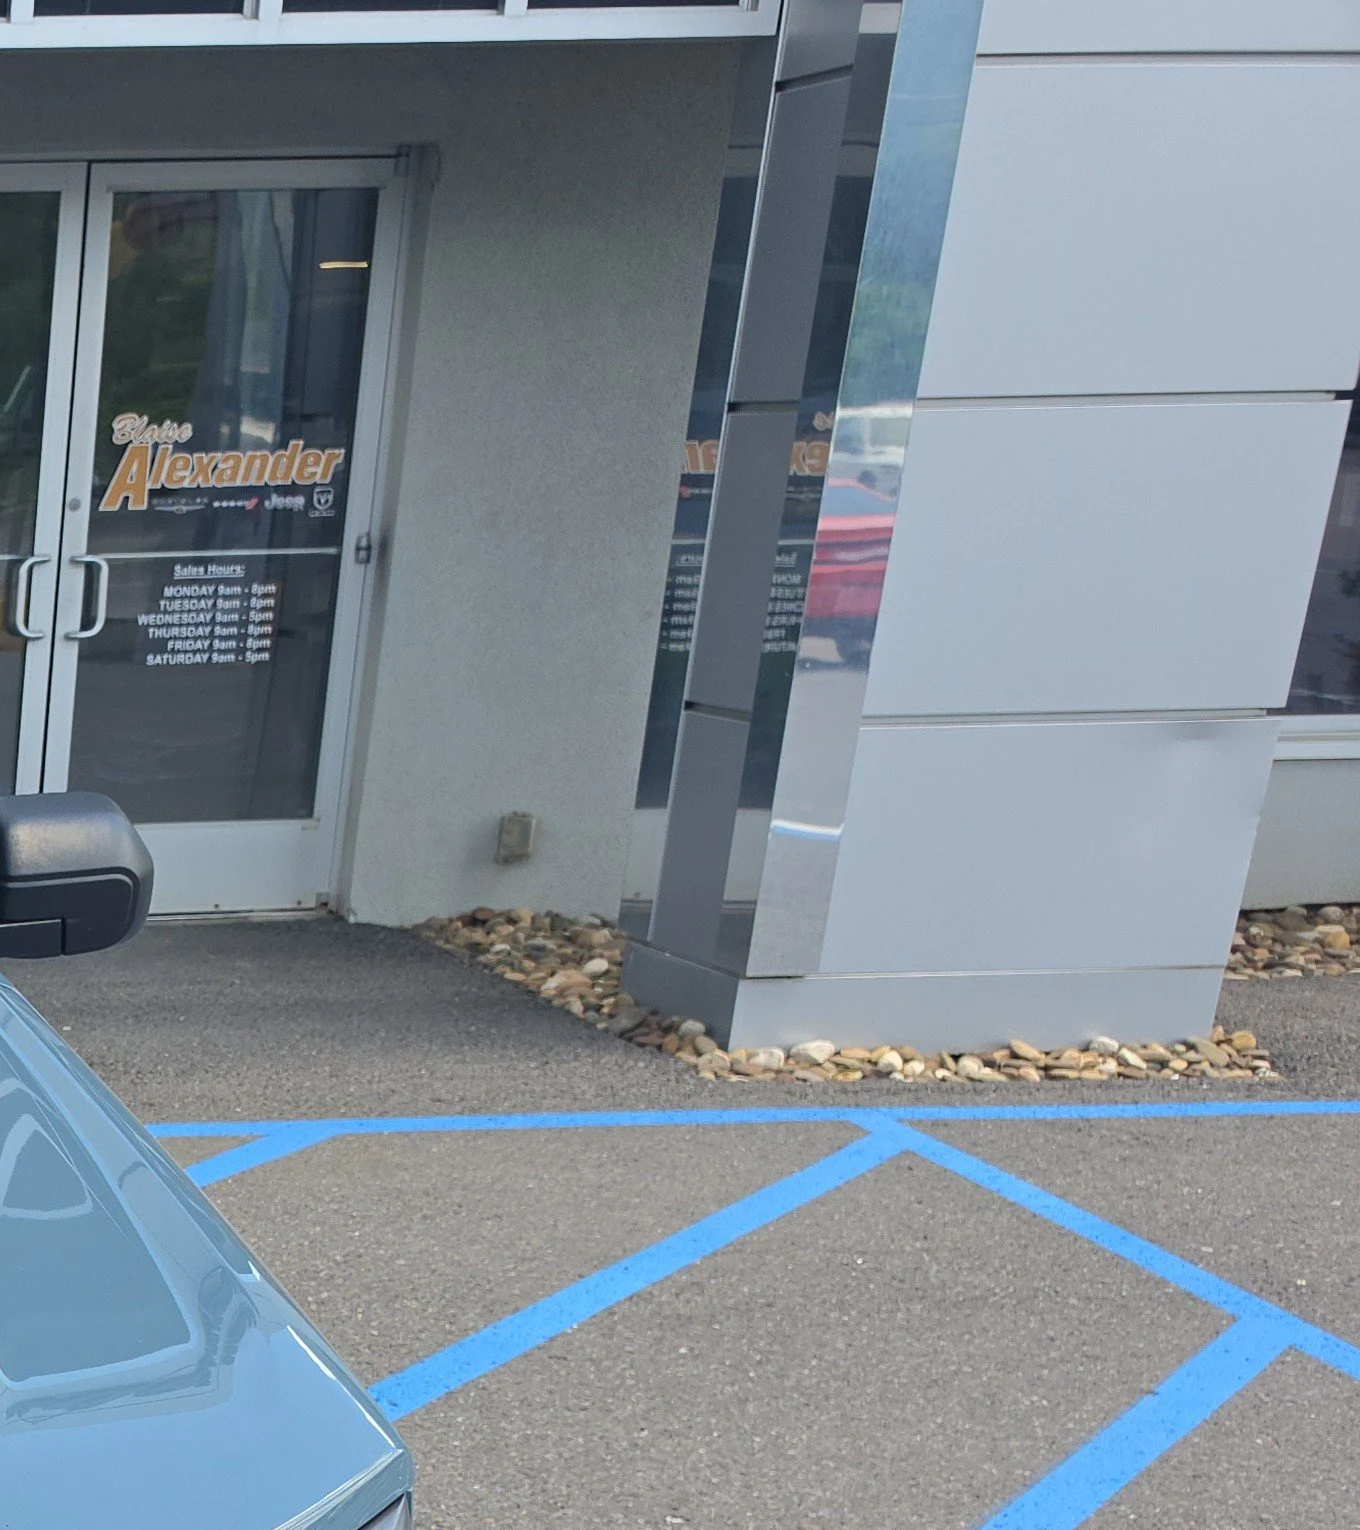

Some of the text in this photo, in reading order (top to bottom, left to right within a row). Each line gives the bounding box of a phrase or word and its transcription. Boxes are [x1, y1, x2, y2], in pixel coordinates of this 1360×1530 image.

[112, 412, 193, 445] Blaise
[98, 439, 345, 511] Alexander
[174, 564, 205, 578] Sales
[163, 583, 216, 597] MONDAY
[159, 598, 215, 611] TUESDAY
[137, 611, 214, 626] WEDNESDAY
[148, 625, 212, 639] THURSDAY
[167, 639, 211, 651] FRIDAY
[146, 652, 210, 666] SATURDAY
